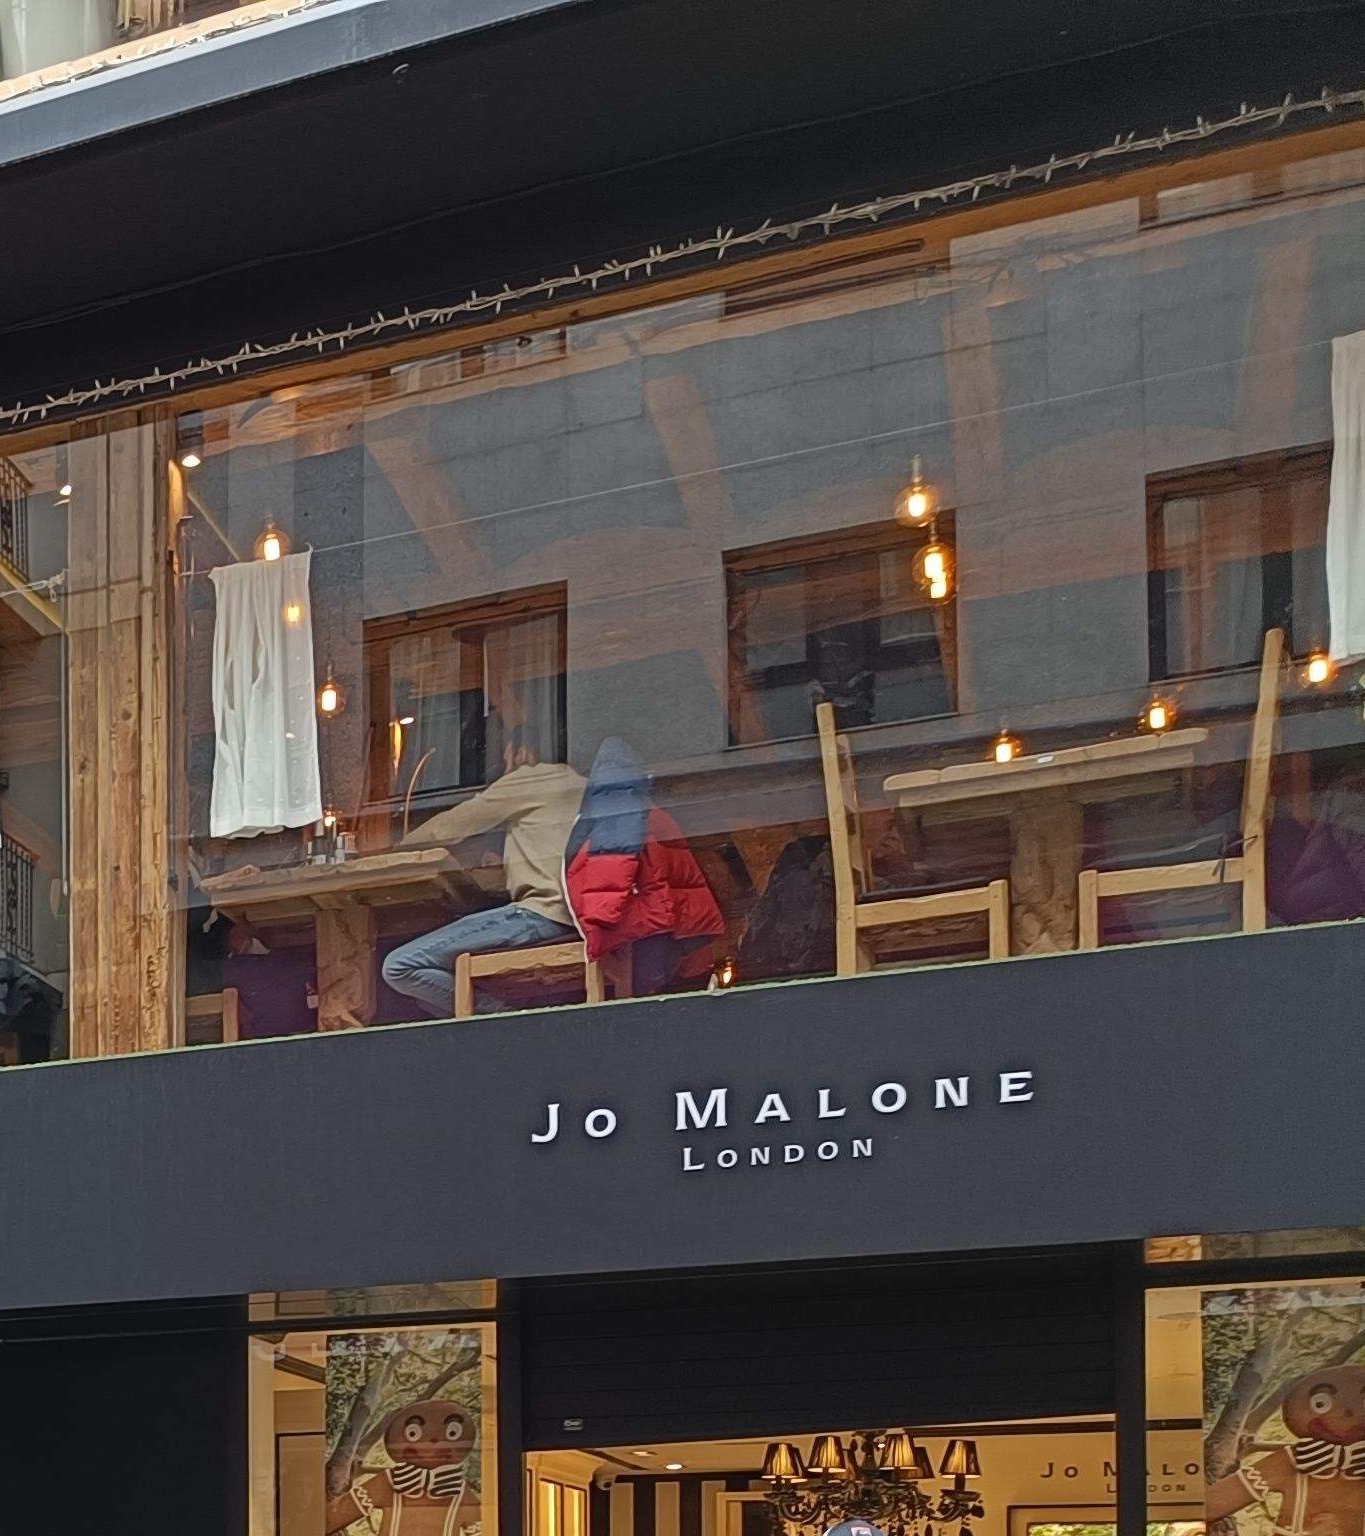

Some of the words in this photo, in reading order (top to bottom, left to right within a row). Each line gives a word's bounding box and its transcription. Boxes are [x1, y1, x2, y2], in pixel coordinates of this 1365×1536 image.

[530, 1102, 618, 1145] Jo
[674, 1070, 1037, 1132] MALONE
[682, 1137, 874, 1172] LONDON
[1040, 1461, 1079, 1479] Jo
[1103, 1460, 1200, 1478] MLO
[1106, 1483, 1187, 1494] LDON
